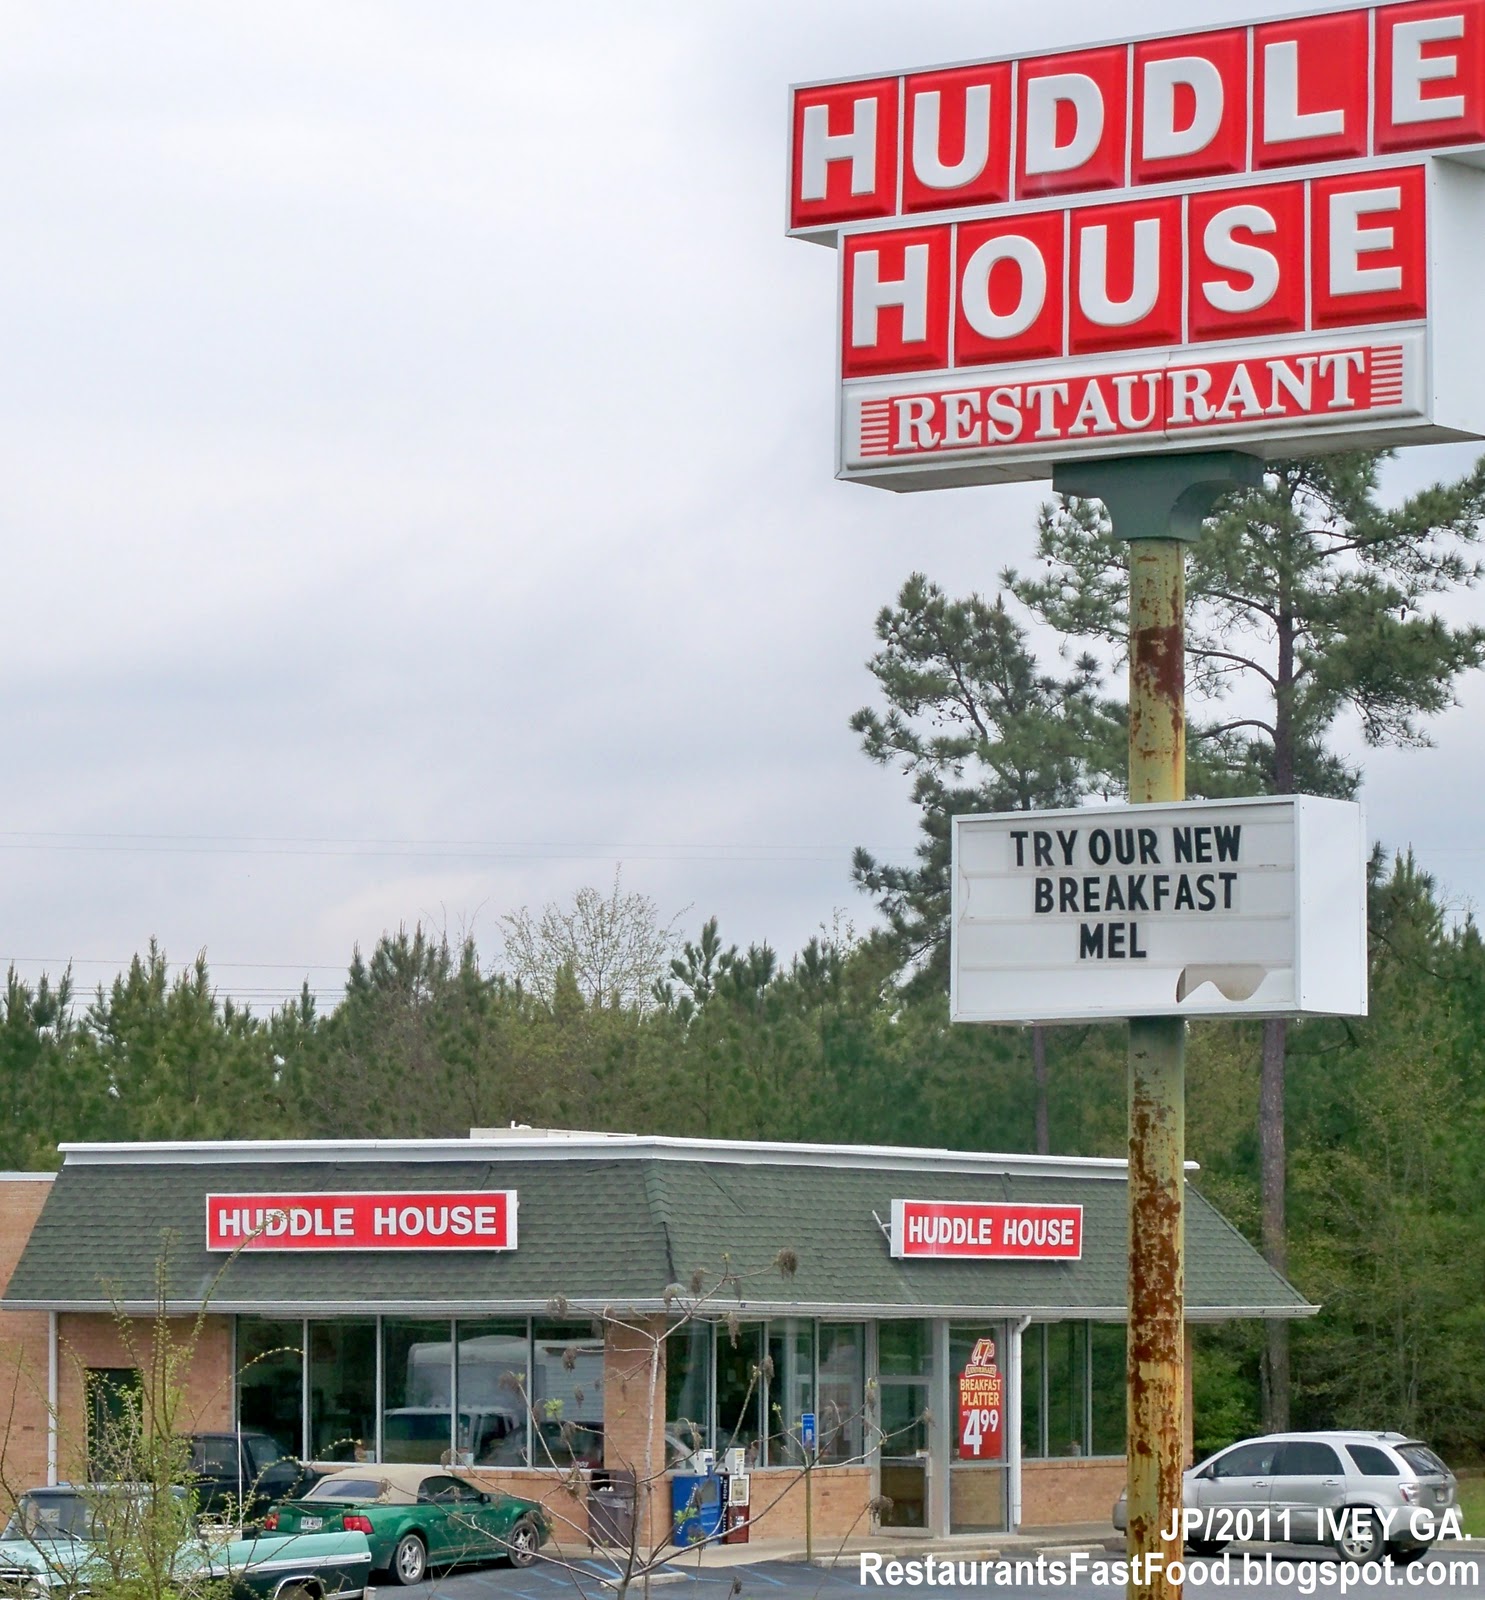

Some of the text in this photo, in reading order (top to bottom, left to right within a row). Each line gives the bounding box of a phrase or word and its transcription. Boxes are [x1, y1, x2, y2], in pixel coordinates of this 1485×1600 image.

[801, 14, 1465, 201] HUDDLE
[851, 186, 1402, 348] HOUSE
[893, 350, 1365, 450] RESTAURANT
[1010, 825, 1242, 867] TRY OUR NEW
[1034, 873, 1238, 914] BREAKFAST
[1079, 922, 1147, 960] MEL
[218, 1205, 497, 1237] HUDDLE HOUSE
[908, 1215, 1075, 1246] HUDDLE HOUSE
[960, 1379, 1002, 1391] BREAKFAST
[962, 1391, 1000, 1406] PLATTER
